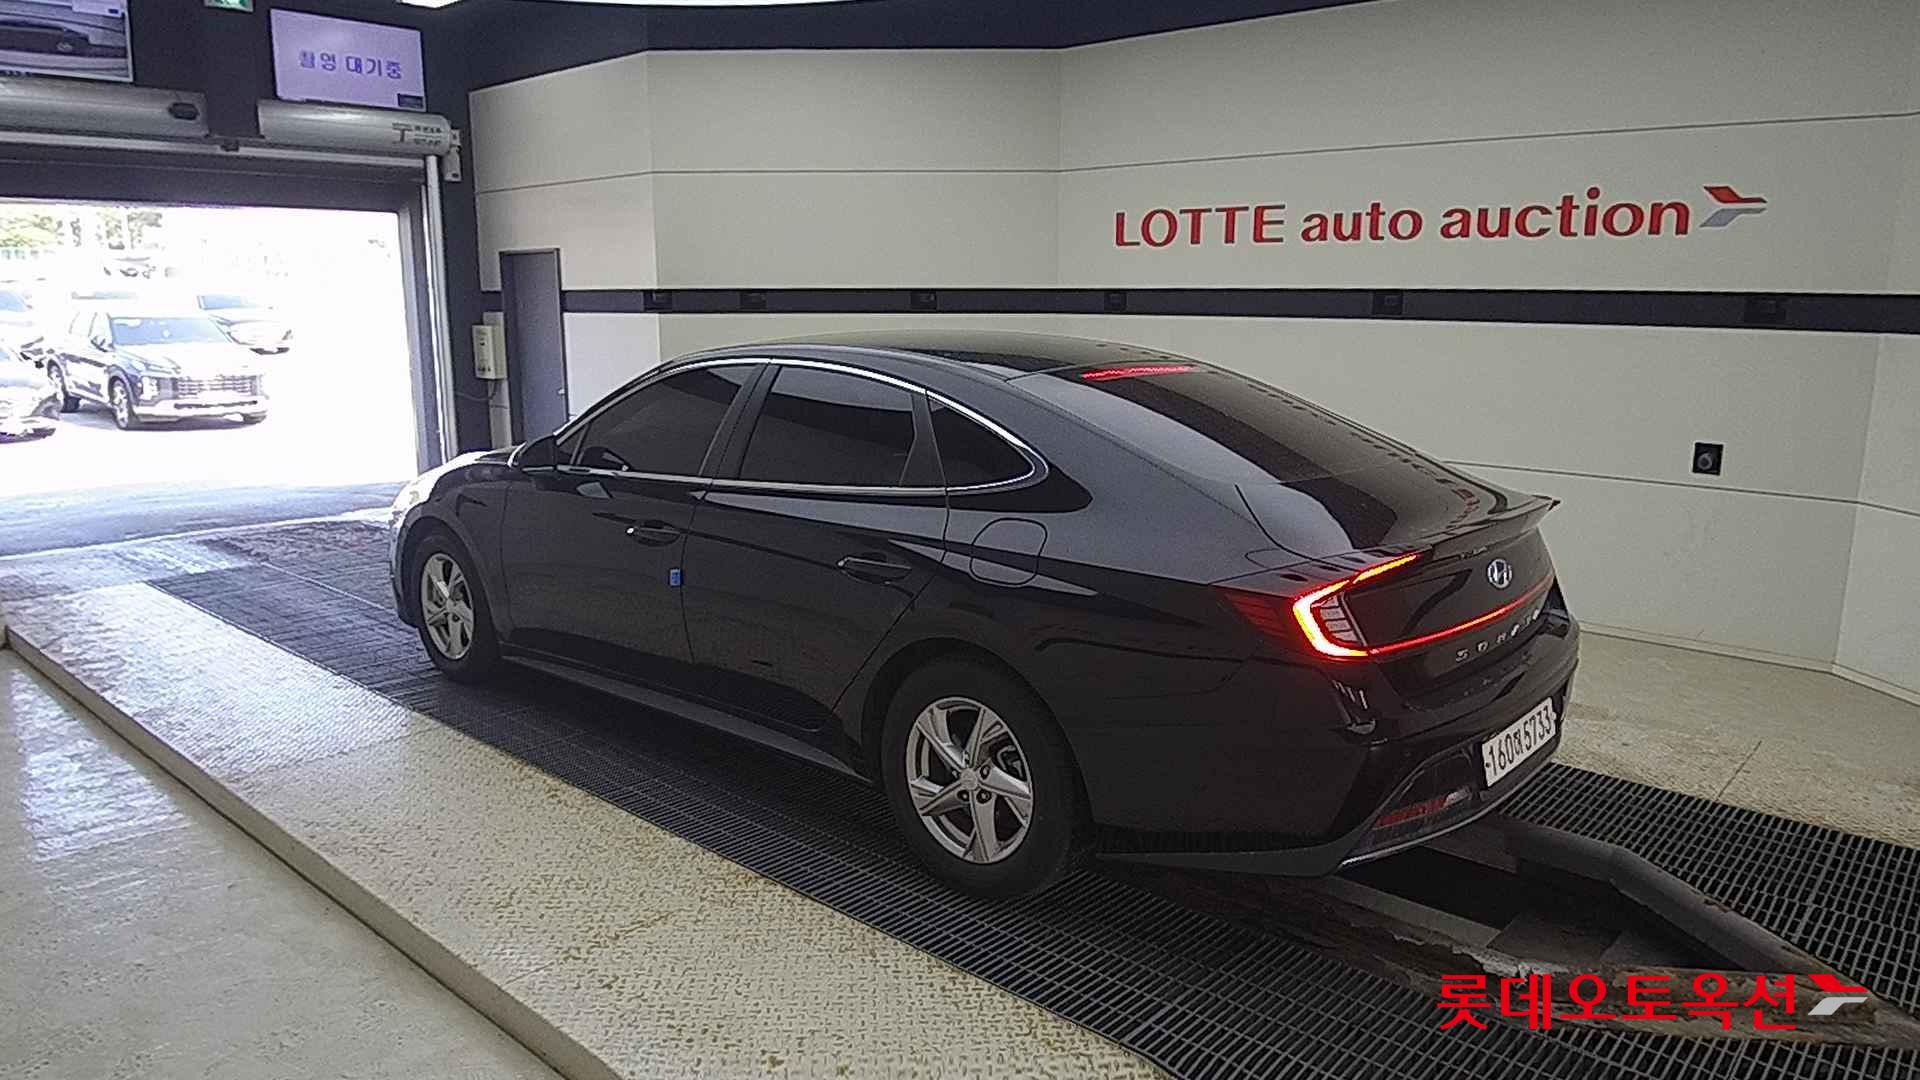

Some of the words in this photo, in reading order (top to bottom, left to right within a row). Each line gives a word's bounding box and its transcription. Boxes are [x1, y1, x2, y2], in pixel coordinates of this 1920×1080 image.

[345, 56, 402, 79] 대기중
[1116, 204, 1285, 246] LOTTE
[1303, 203, 1423, 240] auto
[1441, 188, 1689, 238] auction
